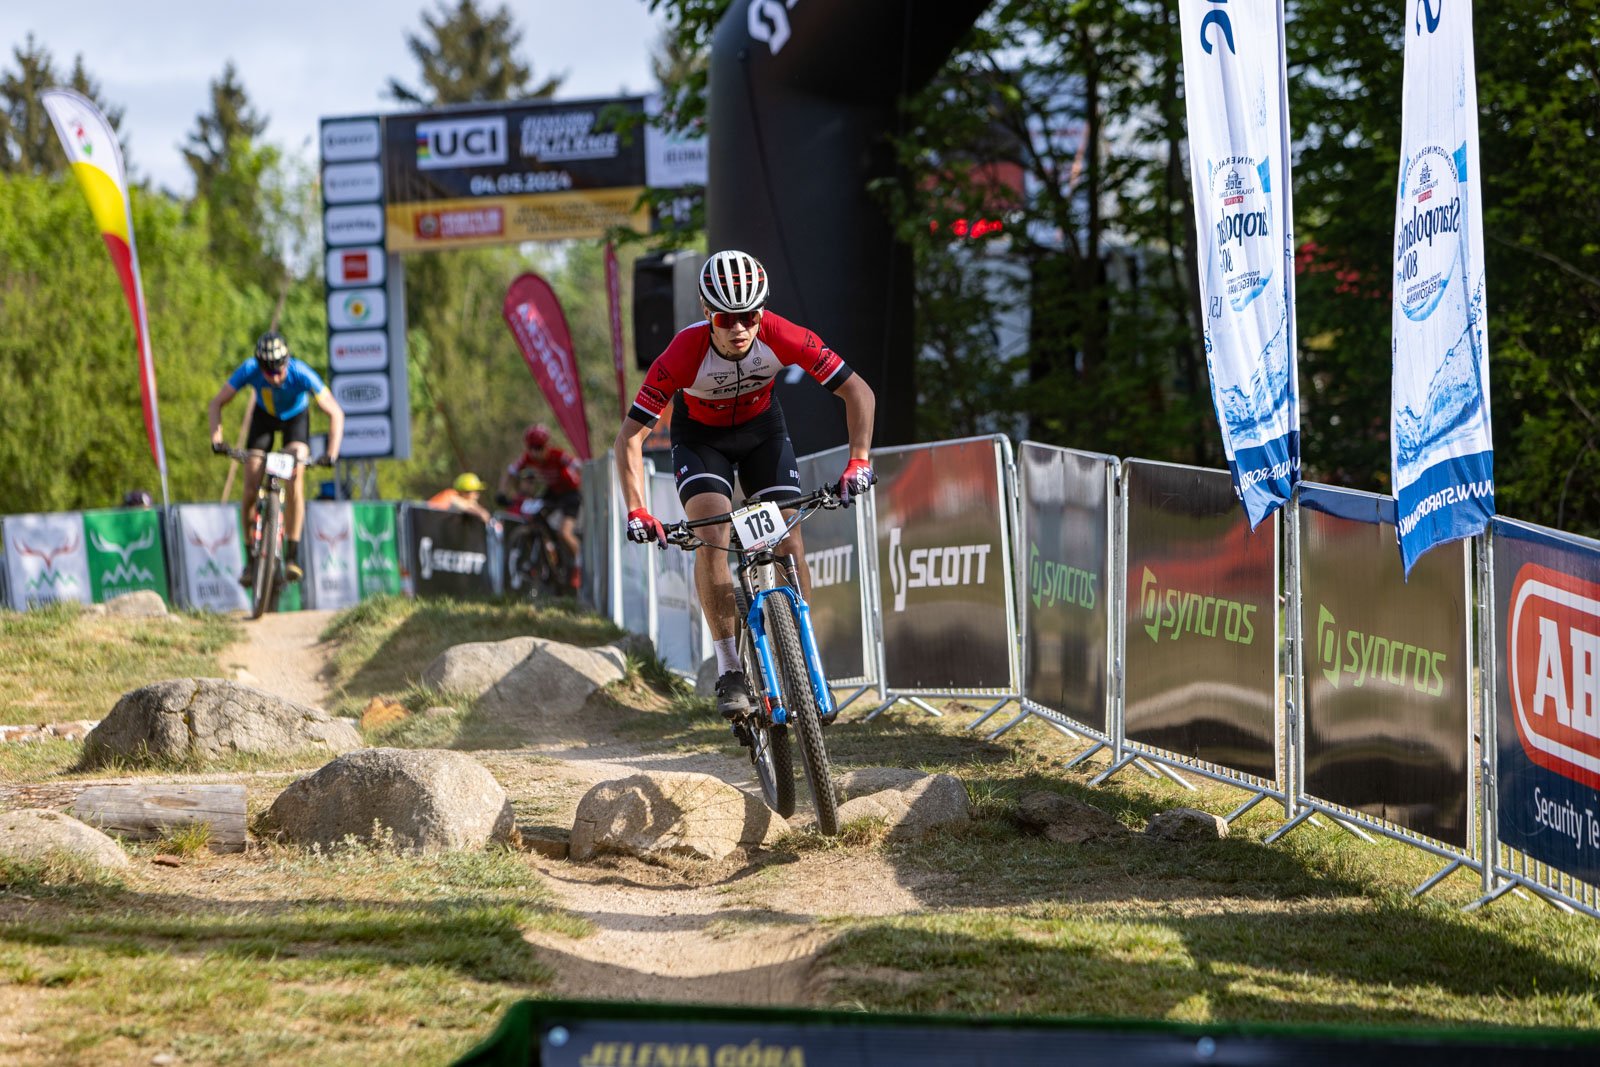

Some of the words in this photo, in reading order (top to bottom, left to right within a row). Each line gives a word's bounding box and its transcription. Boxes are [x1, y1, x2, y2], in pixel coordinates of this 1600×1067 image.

[434, 129, 497, 157] UCI
[713, 382, 762, 394] EMKA
[744, 510, 775, 540] 173
[432, 549, 486, 575] SCOTT
[908, 544, 991, 588] SCOTT
[1534, 787, 1583, 850] Security
[580, 1042, 708, 1067] JELENIA
[714, 1039, 806, 1067] GÓRA
